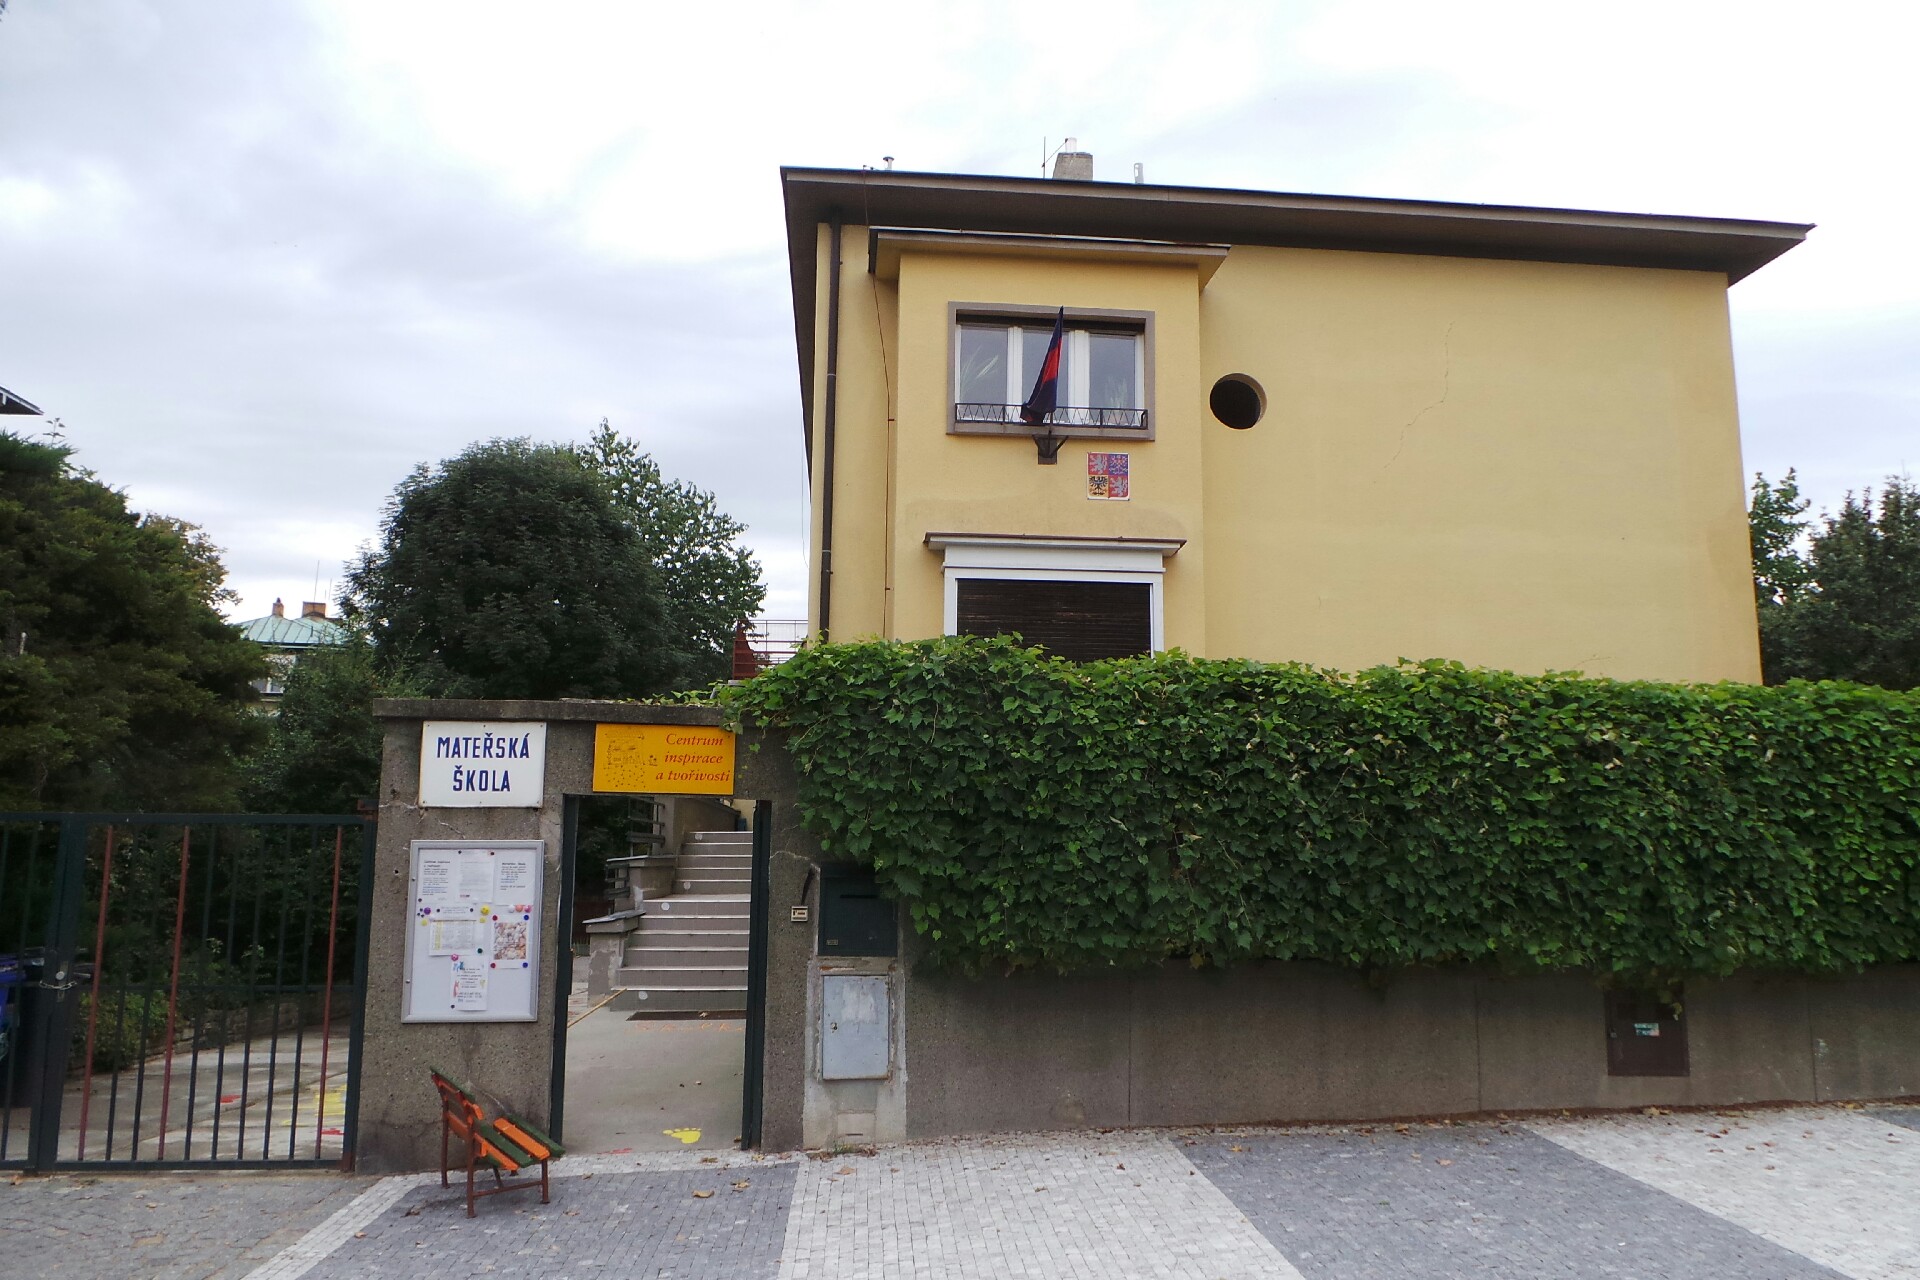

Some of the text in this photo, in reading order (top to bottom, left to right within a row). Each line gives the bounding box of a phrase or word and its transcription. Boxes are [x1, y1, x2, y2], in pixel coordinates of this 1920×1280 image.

[437, 732, 530, 759] MATEŘSKÁ
[666, 733, 724, 746] Centrum
[665, 751, 723, 766] inspirace
[452, 765, 511, 792] ŠKOLA
[655, 769, 731, 782] a tvořivosti
